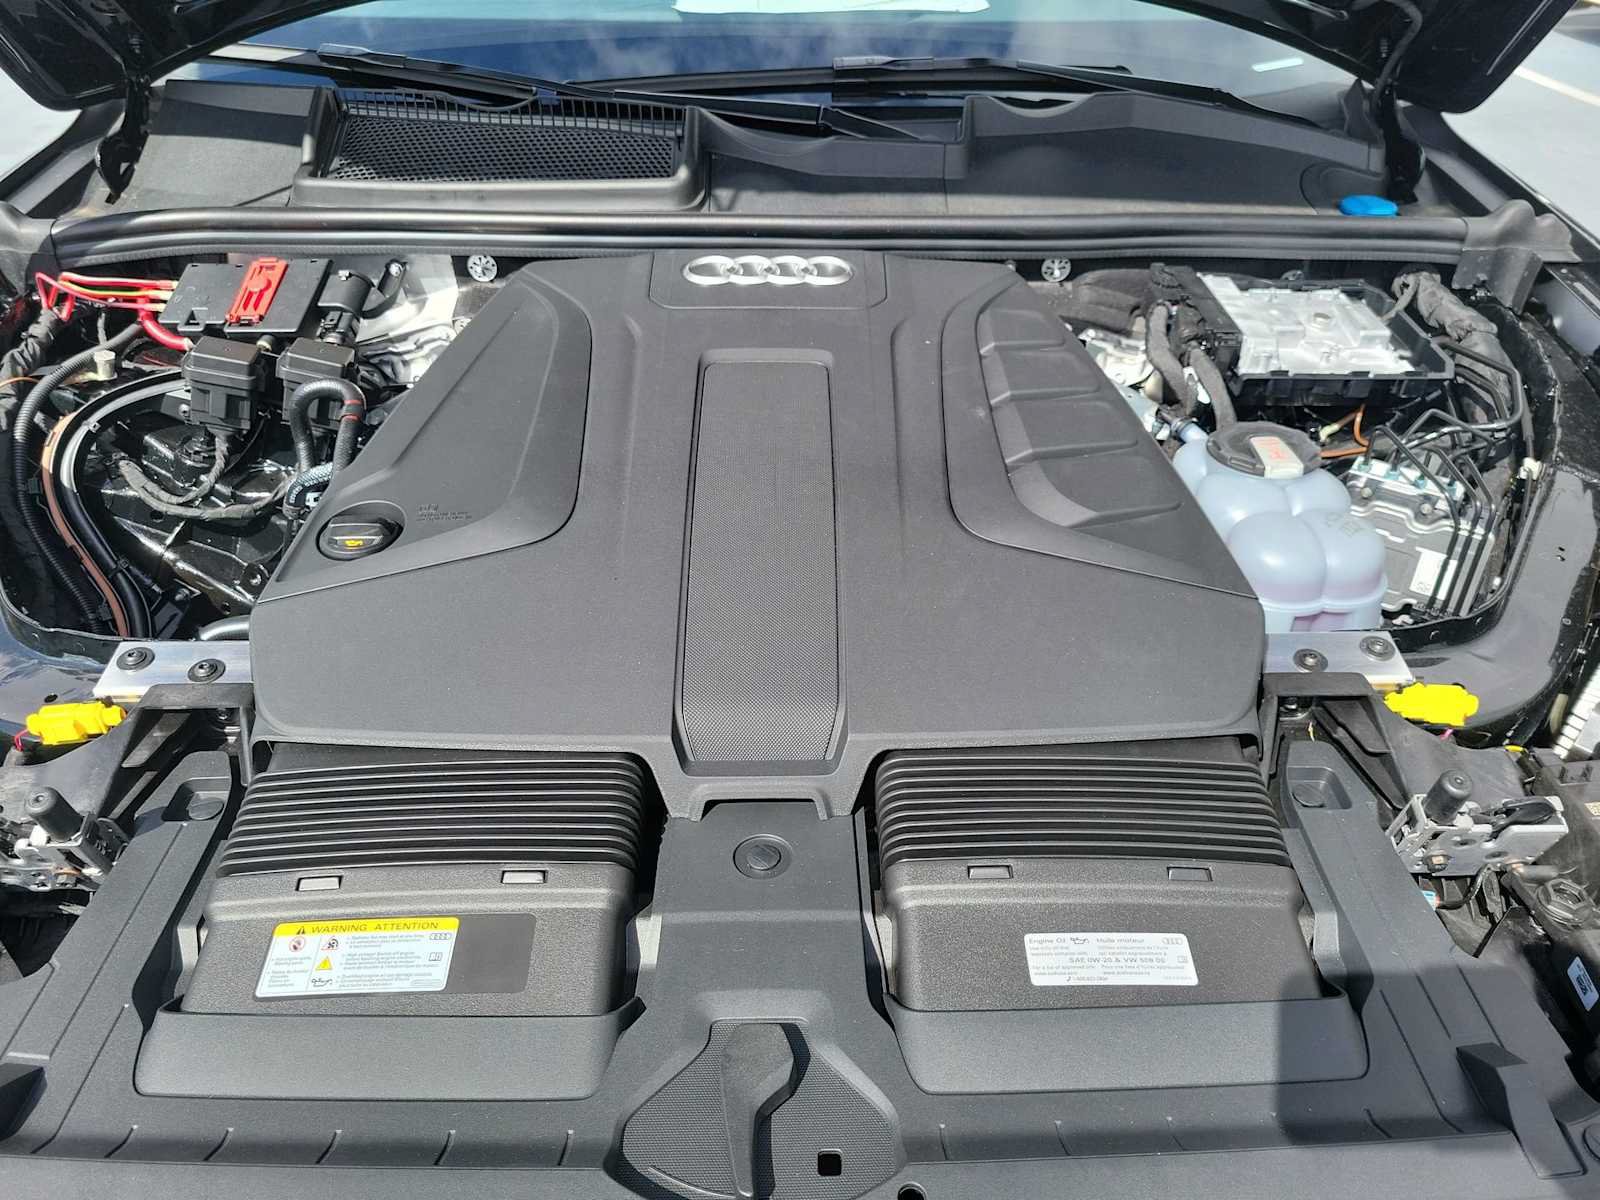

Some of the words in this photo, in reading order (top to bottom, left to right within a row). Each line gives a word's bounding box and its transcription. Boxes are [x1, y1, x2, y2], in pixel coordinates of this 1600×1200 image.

[311, 923, 368, 934] WARNING
[375, 921, 440, 931] ATTENTION
[1029, 937, 1054, 945] Engine
